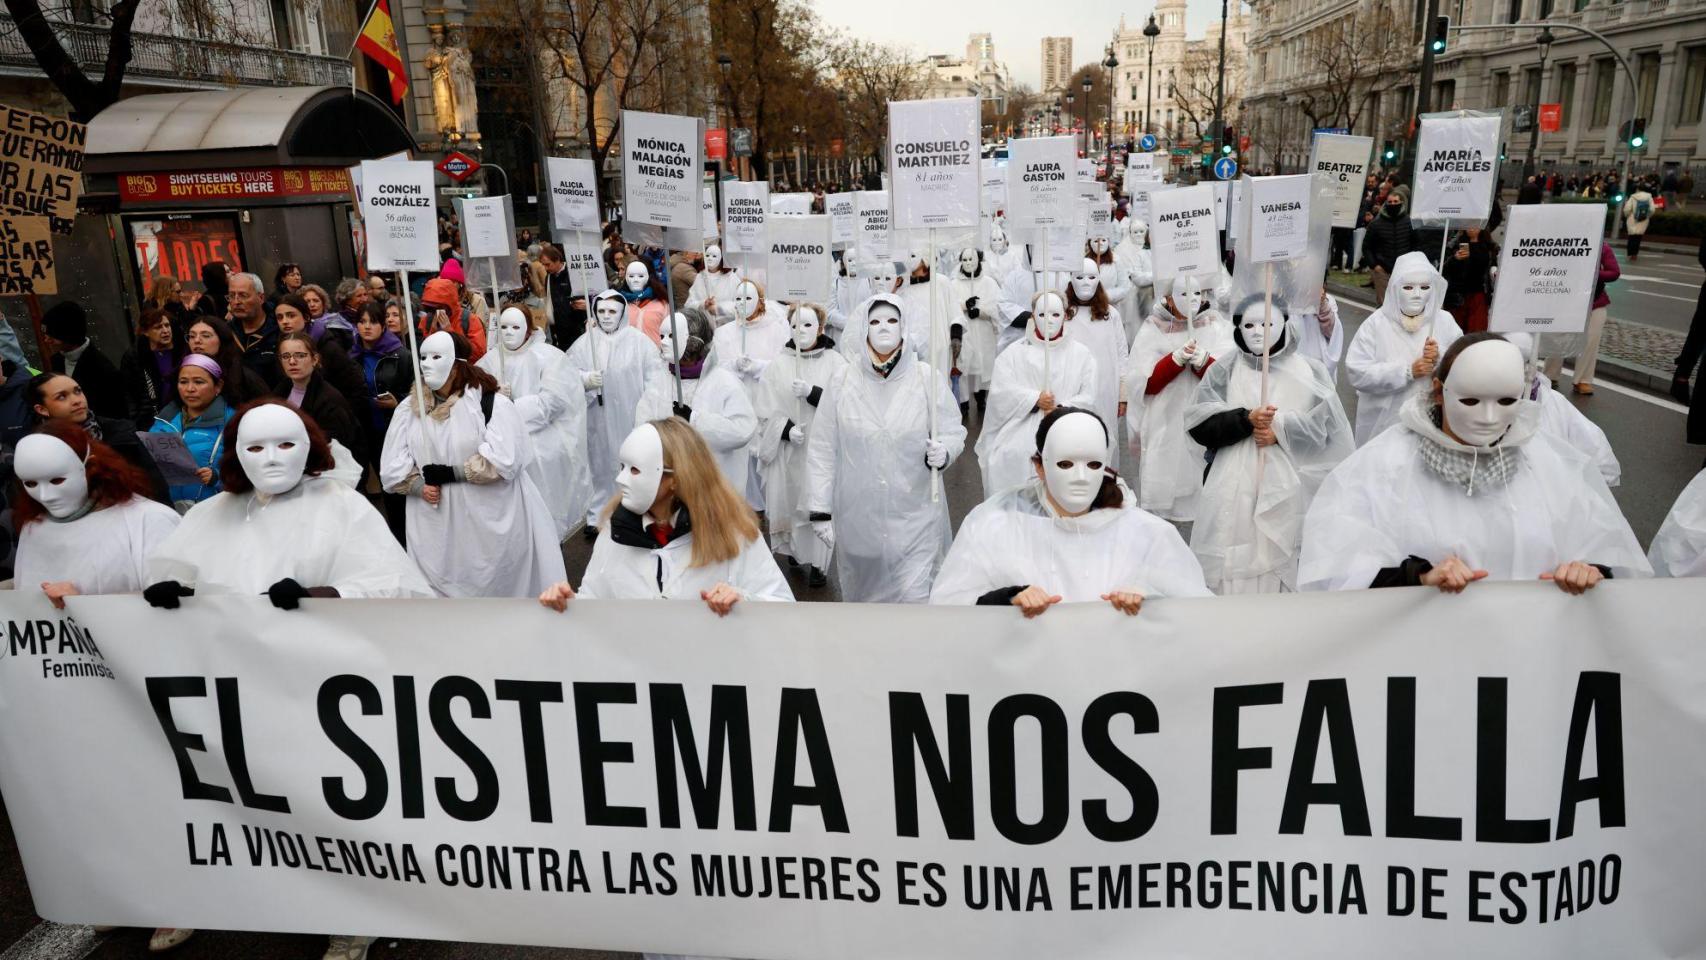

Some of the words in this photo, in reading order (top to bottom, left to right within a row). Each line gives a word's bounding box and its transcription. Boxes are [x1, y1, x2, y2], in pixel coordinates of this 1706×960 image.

[0, 105, 87, 146] ERON
[637, 137, 686, 153] MÓNICA
[894, 140, 970, 154] CONSUELO
[632, 151, 691, 167] MALAGÓN
[1433, 147, 1482, 161] MARÍA
[898, 154, 970, 168] MARTINEZ
[1423, 158, 1491, 172] ÁNGELES
[638, 165, 685, 179] MEGÍAS
[1026, 163, 1061, 173] LAURA
[1317, 161, 1363, 174] BEATRIZ
[127, 176, 143, 185] BIG
[169, 172, 238, 185] SIGHTSEEING
[240, 171, 273, 182] TOURS
[930, 171, 954, 181] años
[1023, 172, 1065, 182] GASTON
[1338, 173, 1349, 182] G.
[26, 169, 74, 201] LAS
[170, 184, 193, 196] BUY
[195, 182, 242, 195] TICKETS
[243, 182, 275, 193] HERE
[378, 184, 422, 194] CONCHI
[560, 181, 584, 189] ALICIA
[657, 182, 677, 192] años
[0, 184, 57, 217] IQUE
[371, 195, 431, 207] GONZÁLEZ
[730, 198, 761, 206] LORENA
[728, 207, 764, 215] REQUENA
[1261, 201, 1301, 213] VANESA
[385, 213, 395, 222] 56
[397, 213, 416, 222] años
[728, 216, 764, 224] PORTERO
[1159, 213, 1180, 222] ANA
[1181, 207, 1211, 219] ELENA
[1176, 219, 1194, 228] G.F.
[1519, 238, 1589, 247] MARGARITA
[771, 244, 824, 255] AMPARO
[1512, 248, 1592, 257] BOSCHONART
[570, 254, 594, 262] LUSA
[1529, 267, 1541, 276] 96
[1543, 267, 1567, 276] años
[145, 676, 291, 814] EL
[317, 674, 850, 834] SISTEMA
[888, 690, 1160, 846] NOS
[1210, 670, 1627, 844] FALLA
[186, 822, 233, 866] LA
[241, 824, 426, 884] VIOLENCIA
[434, 843, 591, 893] CONTRA
[602, 851, 678, 896] LAS
[691, 853, 881, 903] MUJERES
[896, 860, 947, 908] ES
[963, 864, 1053, 912] UNA
[1070, 860, 1368, 915] EMERGENCIA
[1387, 865, 1448, 920] DE
[1468, 853, 1622, 925] ESTADO
